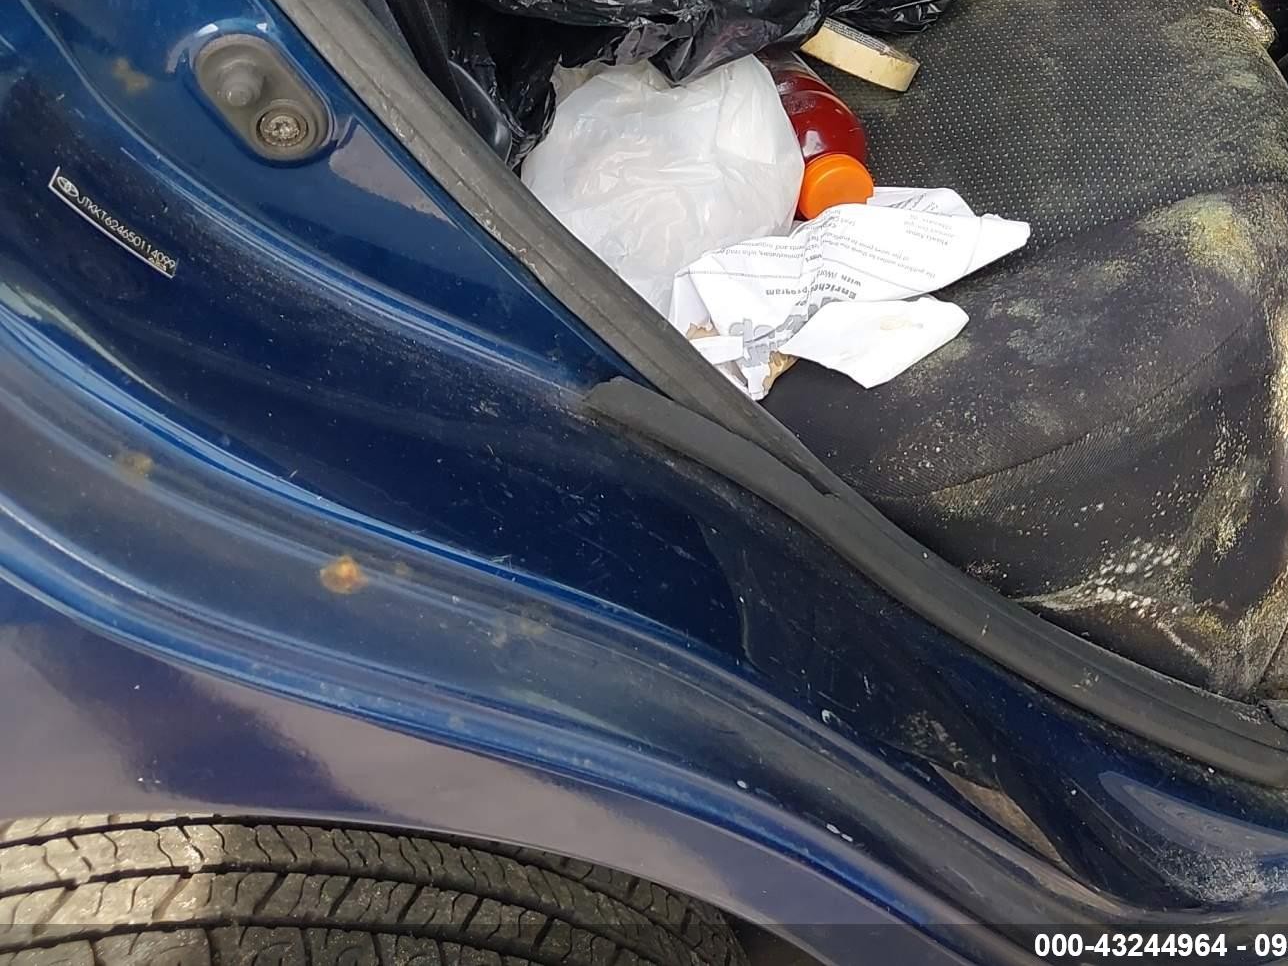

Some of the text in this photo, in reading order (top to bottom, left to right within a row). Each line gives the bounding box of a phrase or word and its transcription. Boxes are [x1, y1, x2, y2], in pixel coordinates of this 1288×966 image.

[76, 195, 176, 269] JTKKT624650114099
[840, 274, 861, 288] with
[765, 286, 808, 297] program
